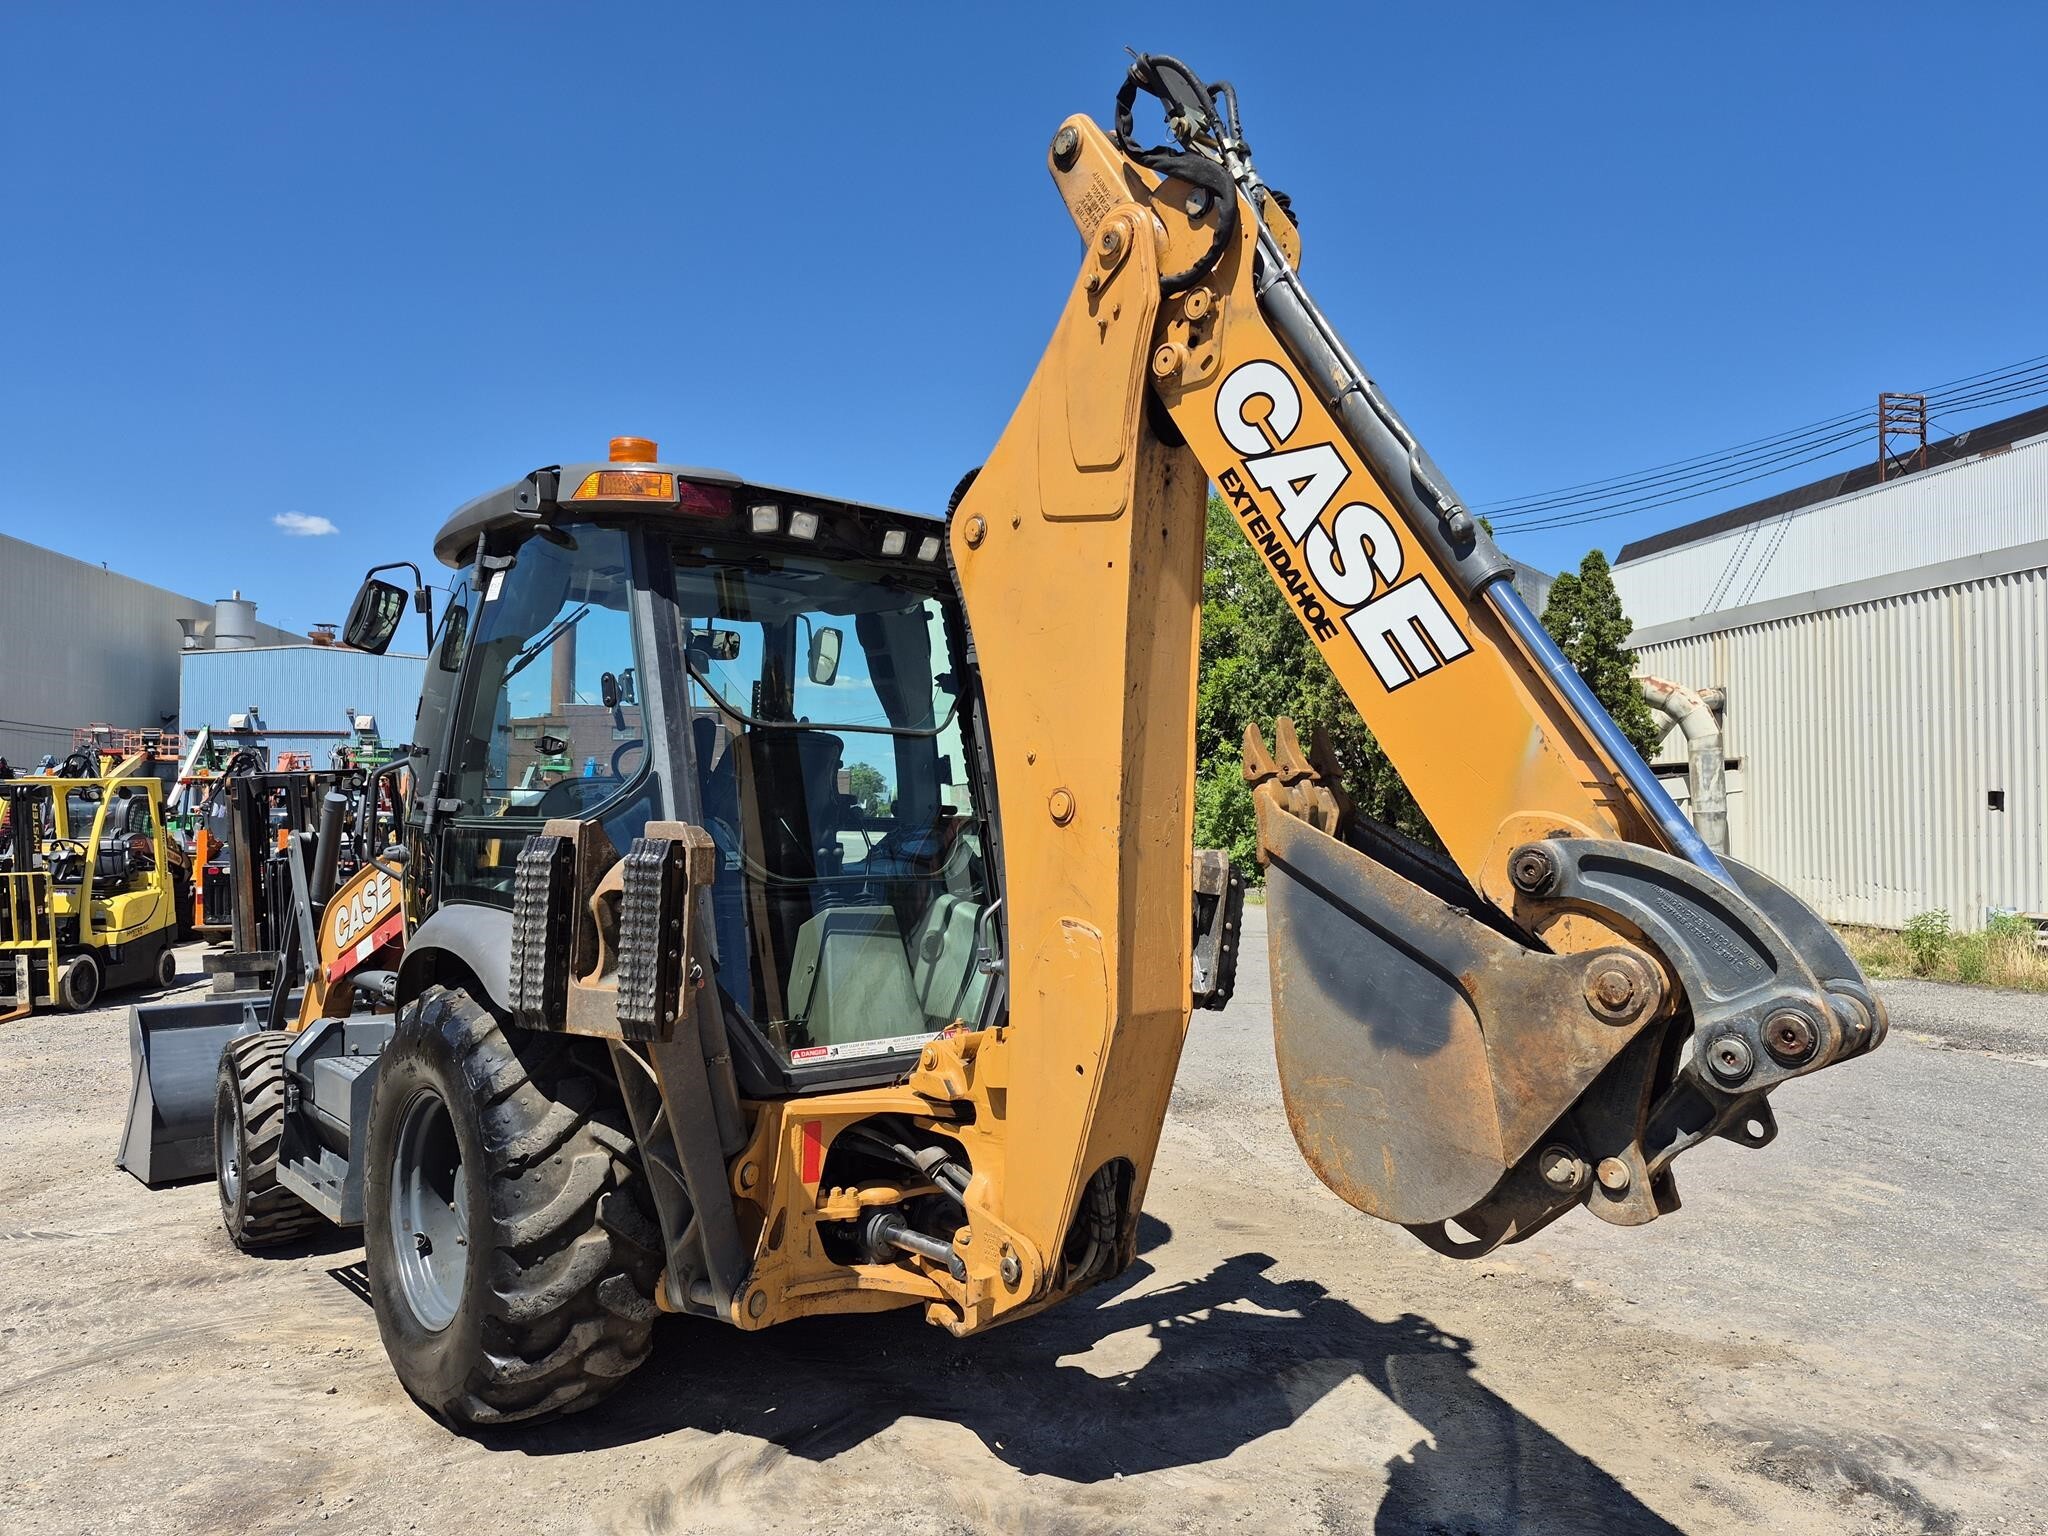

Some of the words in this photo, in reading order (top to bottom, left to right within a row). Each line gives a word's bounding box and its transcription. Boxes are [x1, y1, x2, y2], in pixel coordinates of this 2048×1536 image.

[1214, 359, 1474, 693] CASE
[1217, 467, 1339, 643] EXTENDAHOE
[32, 803, 41, 852] HYSTER
[334, 871, 391, 948] CASE
[800, 1048, 826, 1057] DANGER
